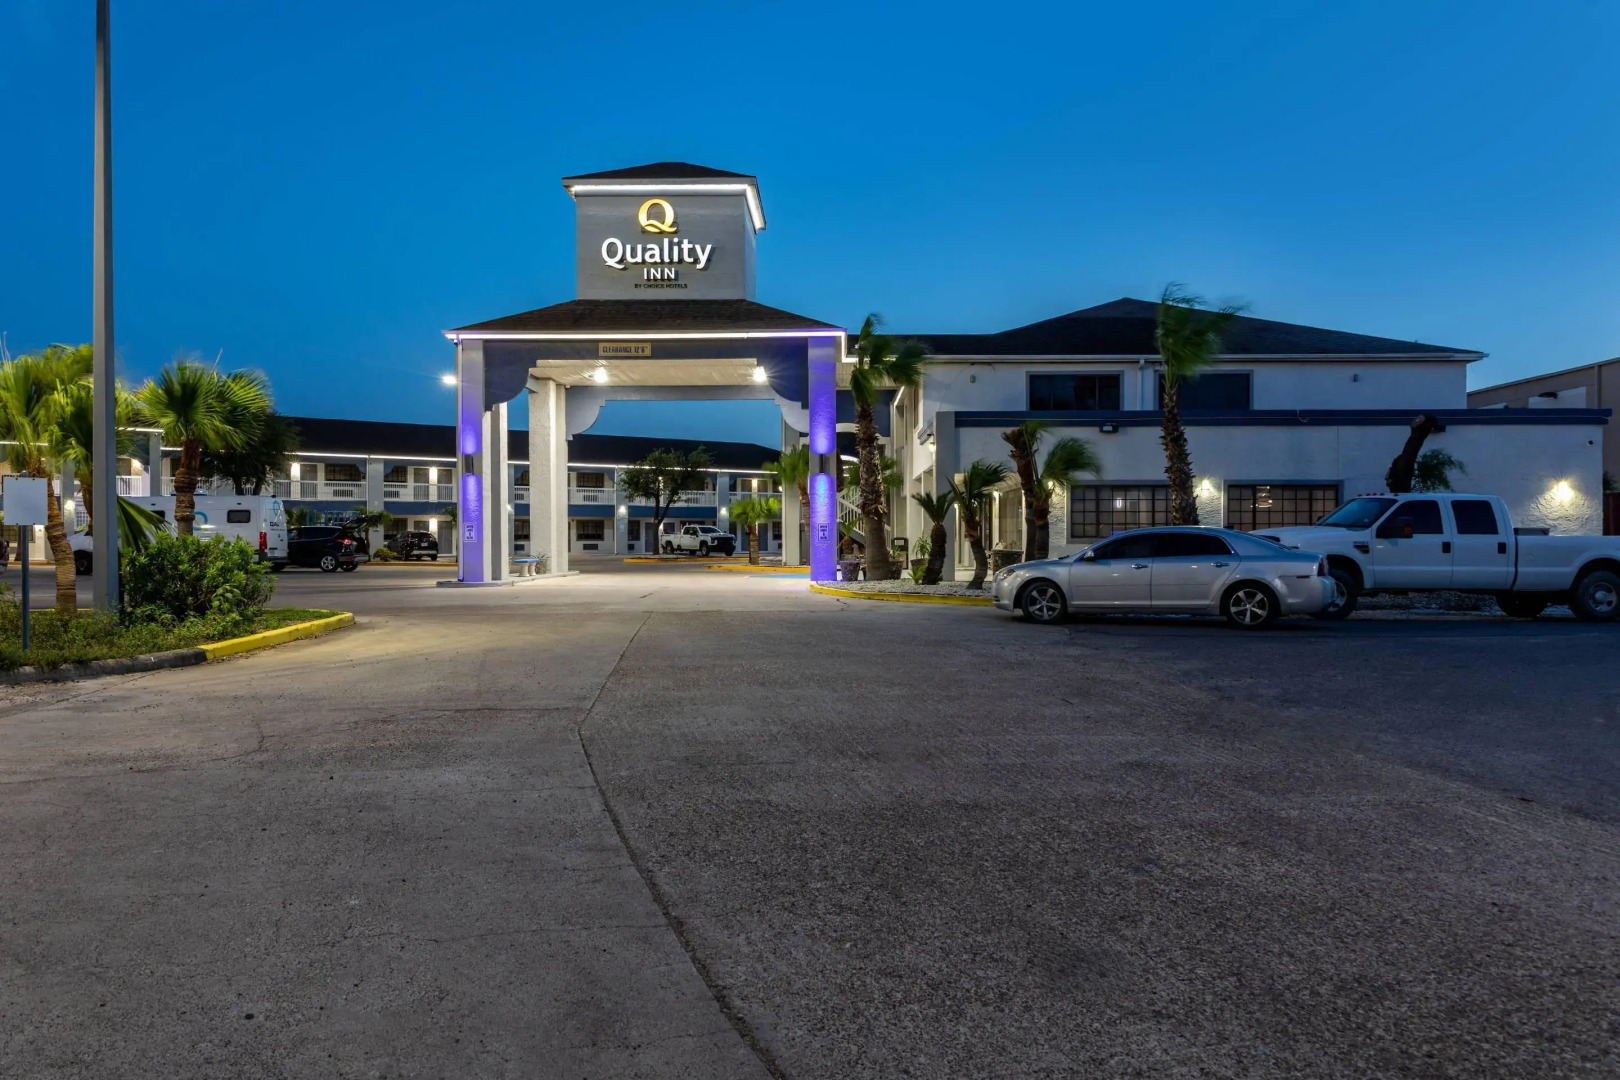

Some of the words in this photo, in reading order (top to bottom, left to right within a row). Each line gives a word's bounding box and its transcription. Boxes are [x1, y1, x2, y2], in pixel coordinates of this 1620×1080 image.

[638, 198, 677, 232] Q
[601, 238, 712, 269] Quality
[643, 268, 675, 280] INN
[602, 345, 632, 354] CLEARANCE
